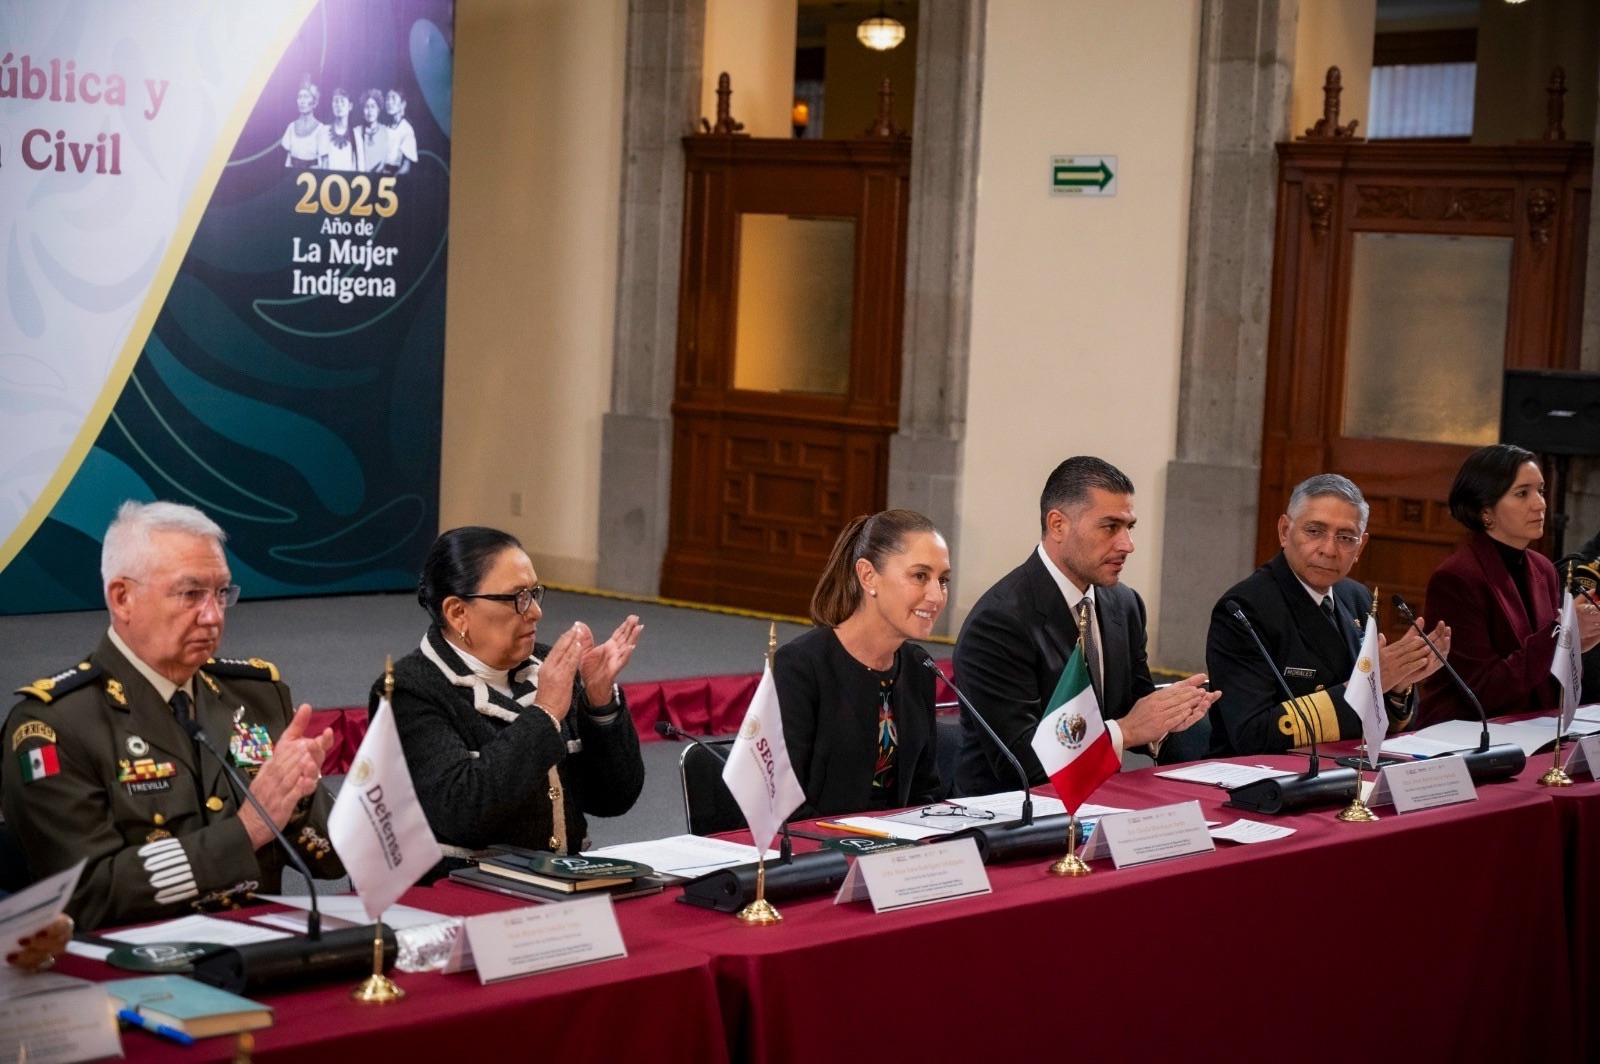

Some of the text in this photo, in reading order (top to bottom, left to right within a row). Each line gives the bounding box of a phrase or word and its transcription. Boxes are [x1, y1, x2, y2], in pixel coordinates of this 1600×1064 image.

[144, 78, 170, 121] y
[21, 128, 122, 176] Civil
[294, 172, 399, 218] 2025
[320, 216, 374, 236] Año de
[292, 238, 399, 273] La Mujer
[292, 270, 396, 303] Indígena
[131, 780, 170, 792] TREVILLA
[366, 785, 403, 868] Defensa
